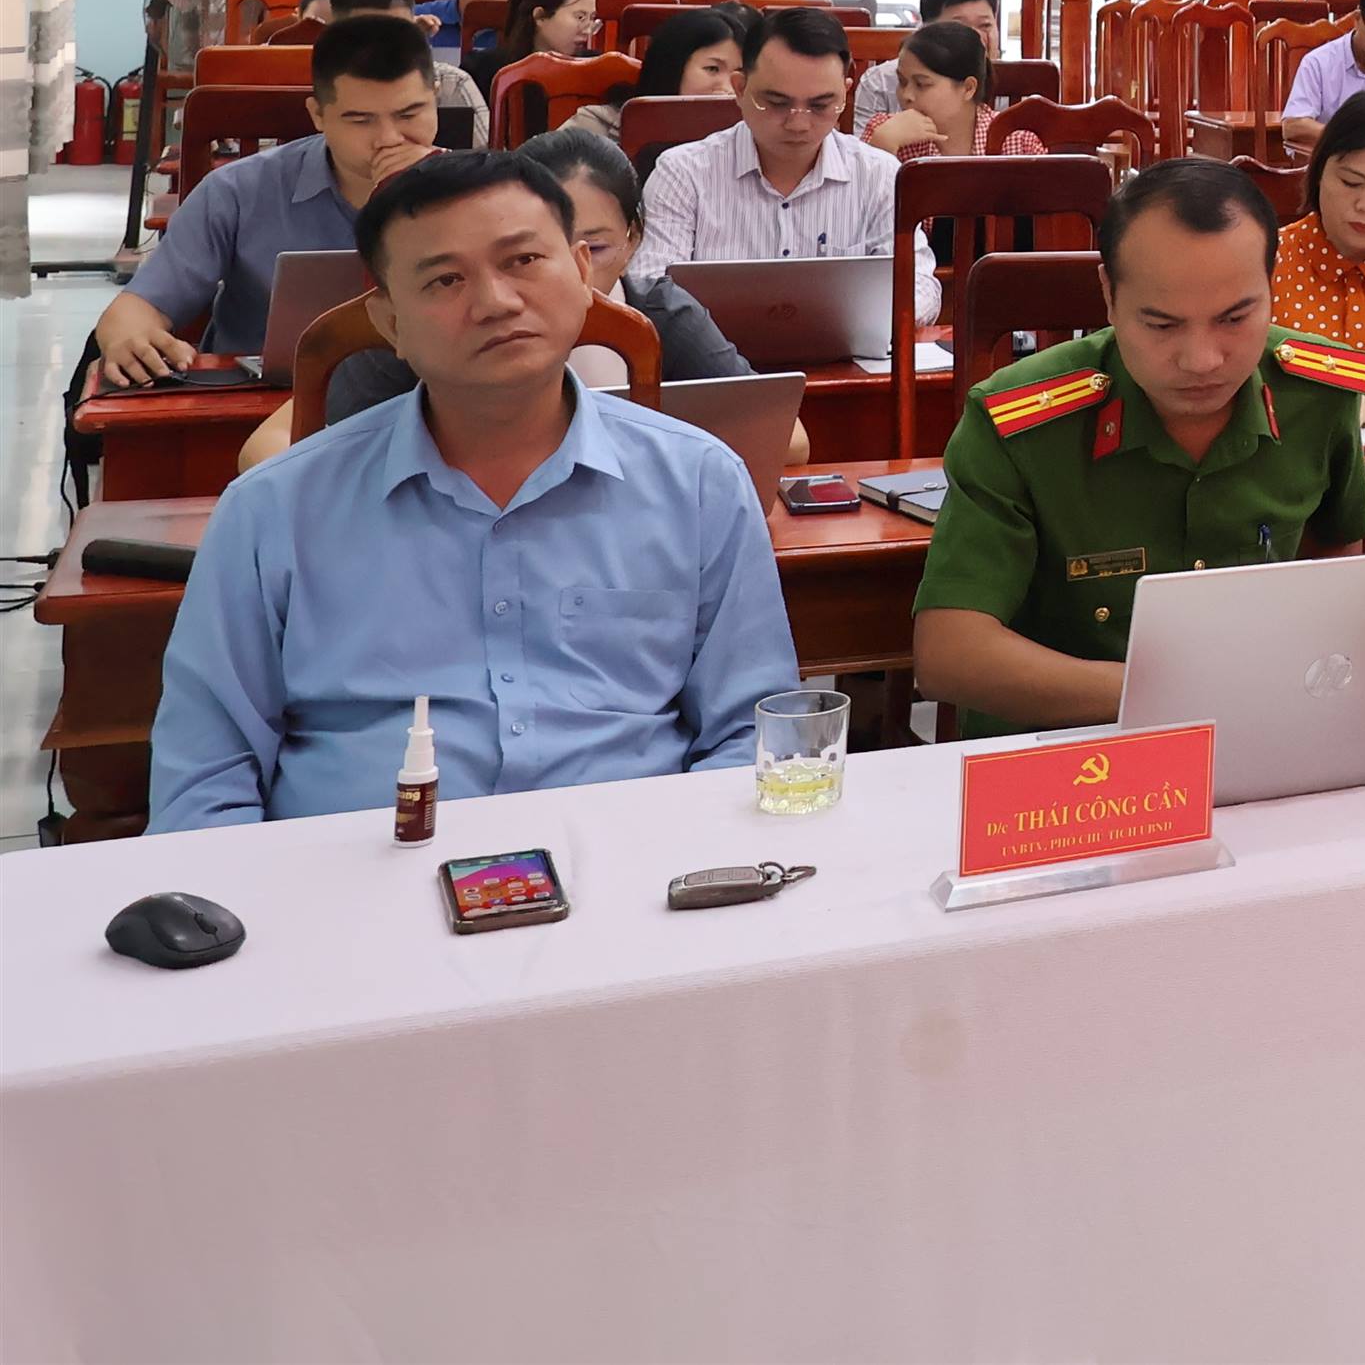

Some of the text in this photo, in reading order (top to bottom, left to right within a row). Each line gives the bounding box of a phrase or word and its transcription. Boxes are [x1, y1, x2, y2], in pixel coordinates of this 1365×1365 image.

[1014, 801, 1069, 832] THÁI
[1075, 795, 1137, 823] CÔNG
[1143, 781, 1189, 811] CẦN
